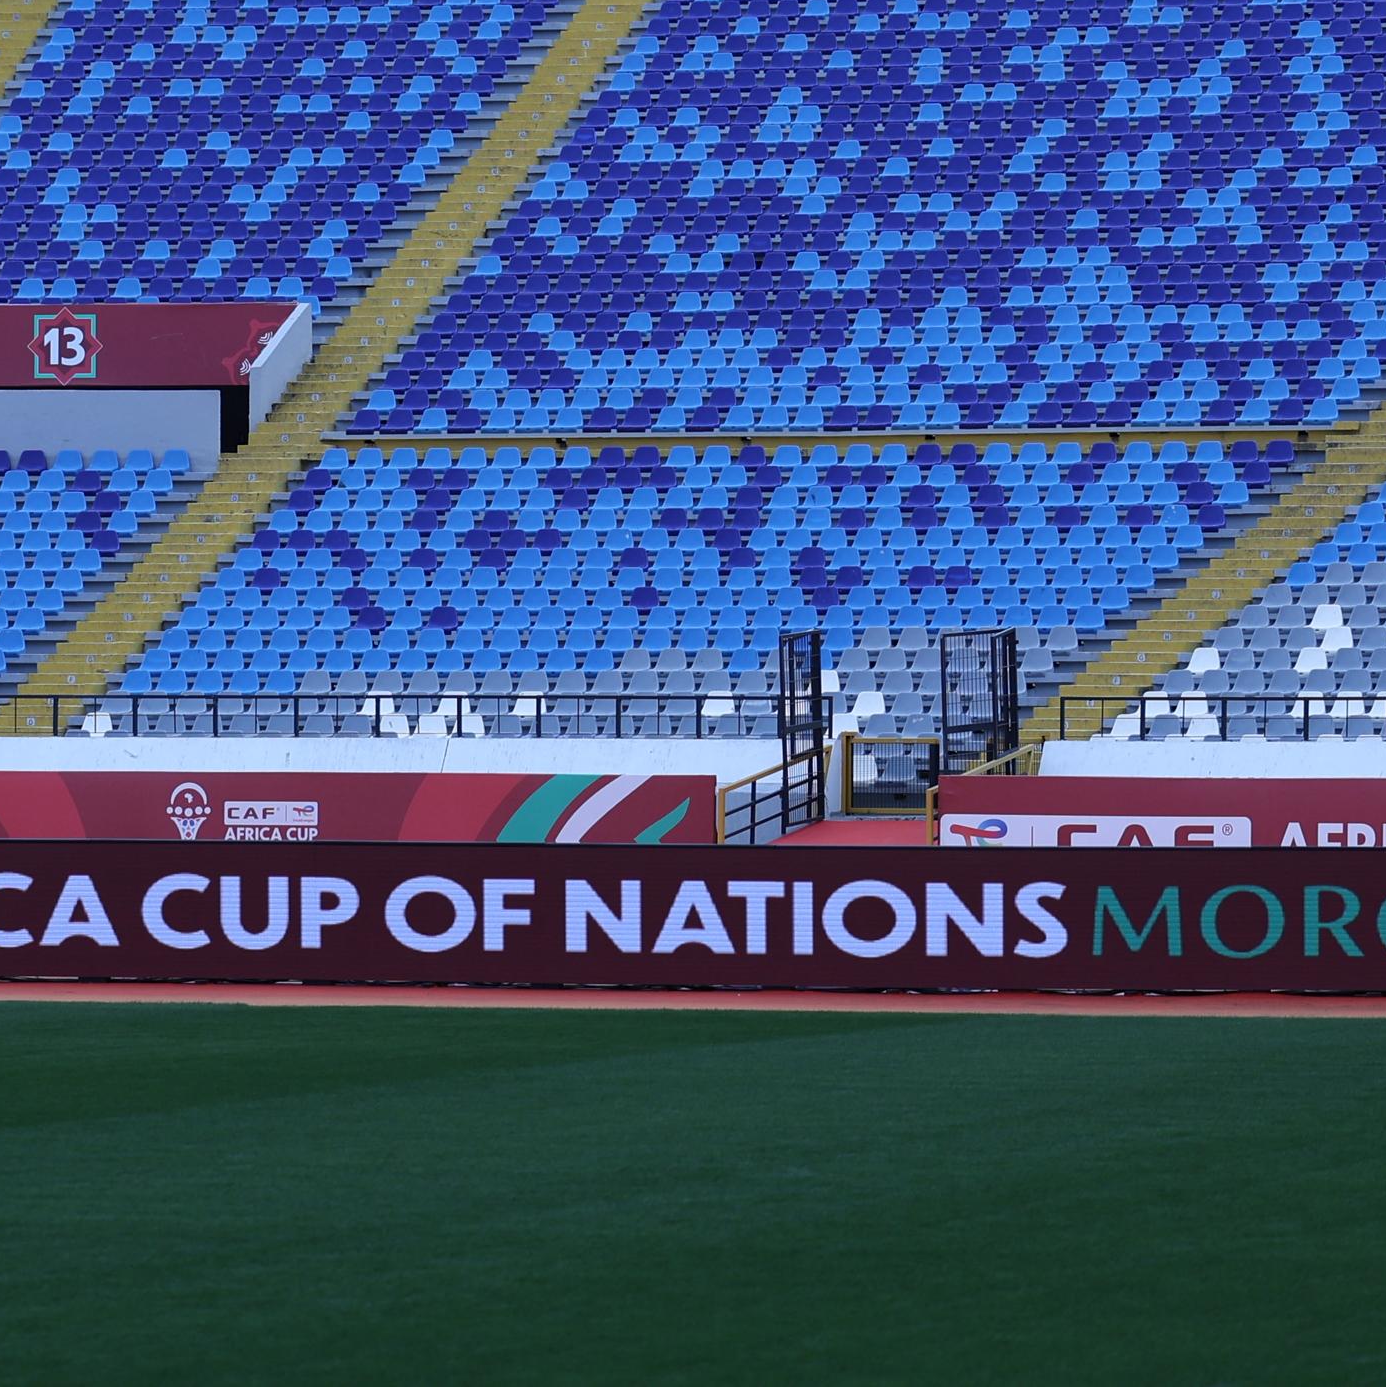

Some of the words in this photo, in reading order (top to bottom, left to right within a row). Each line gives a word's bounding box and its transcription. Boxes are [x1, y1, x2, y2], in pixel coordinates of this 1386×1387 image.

[44, 327, 85, 365] 13
[228, 807, 274, 819] CAF
[224, 827, 282, 841] AFRICA
[286, 827, 318, 841] CUP
[142, 874, 359, 950] CUP
[385, 876, 535, 952] OF
[566, 880, 1067, 957] NATIONS
